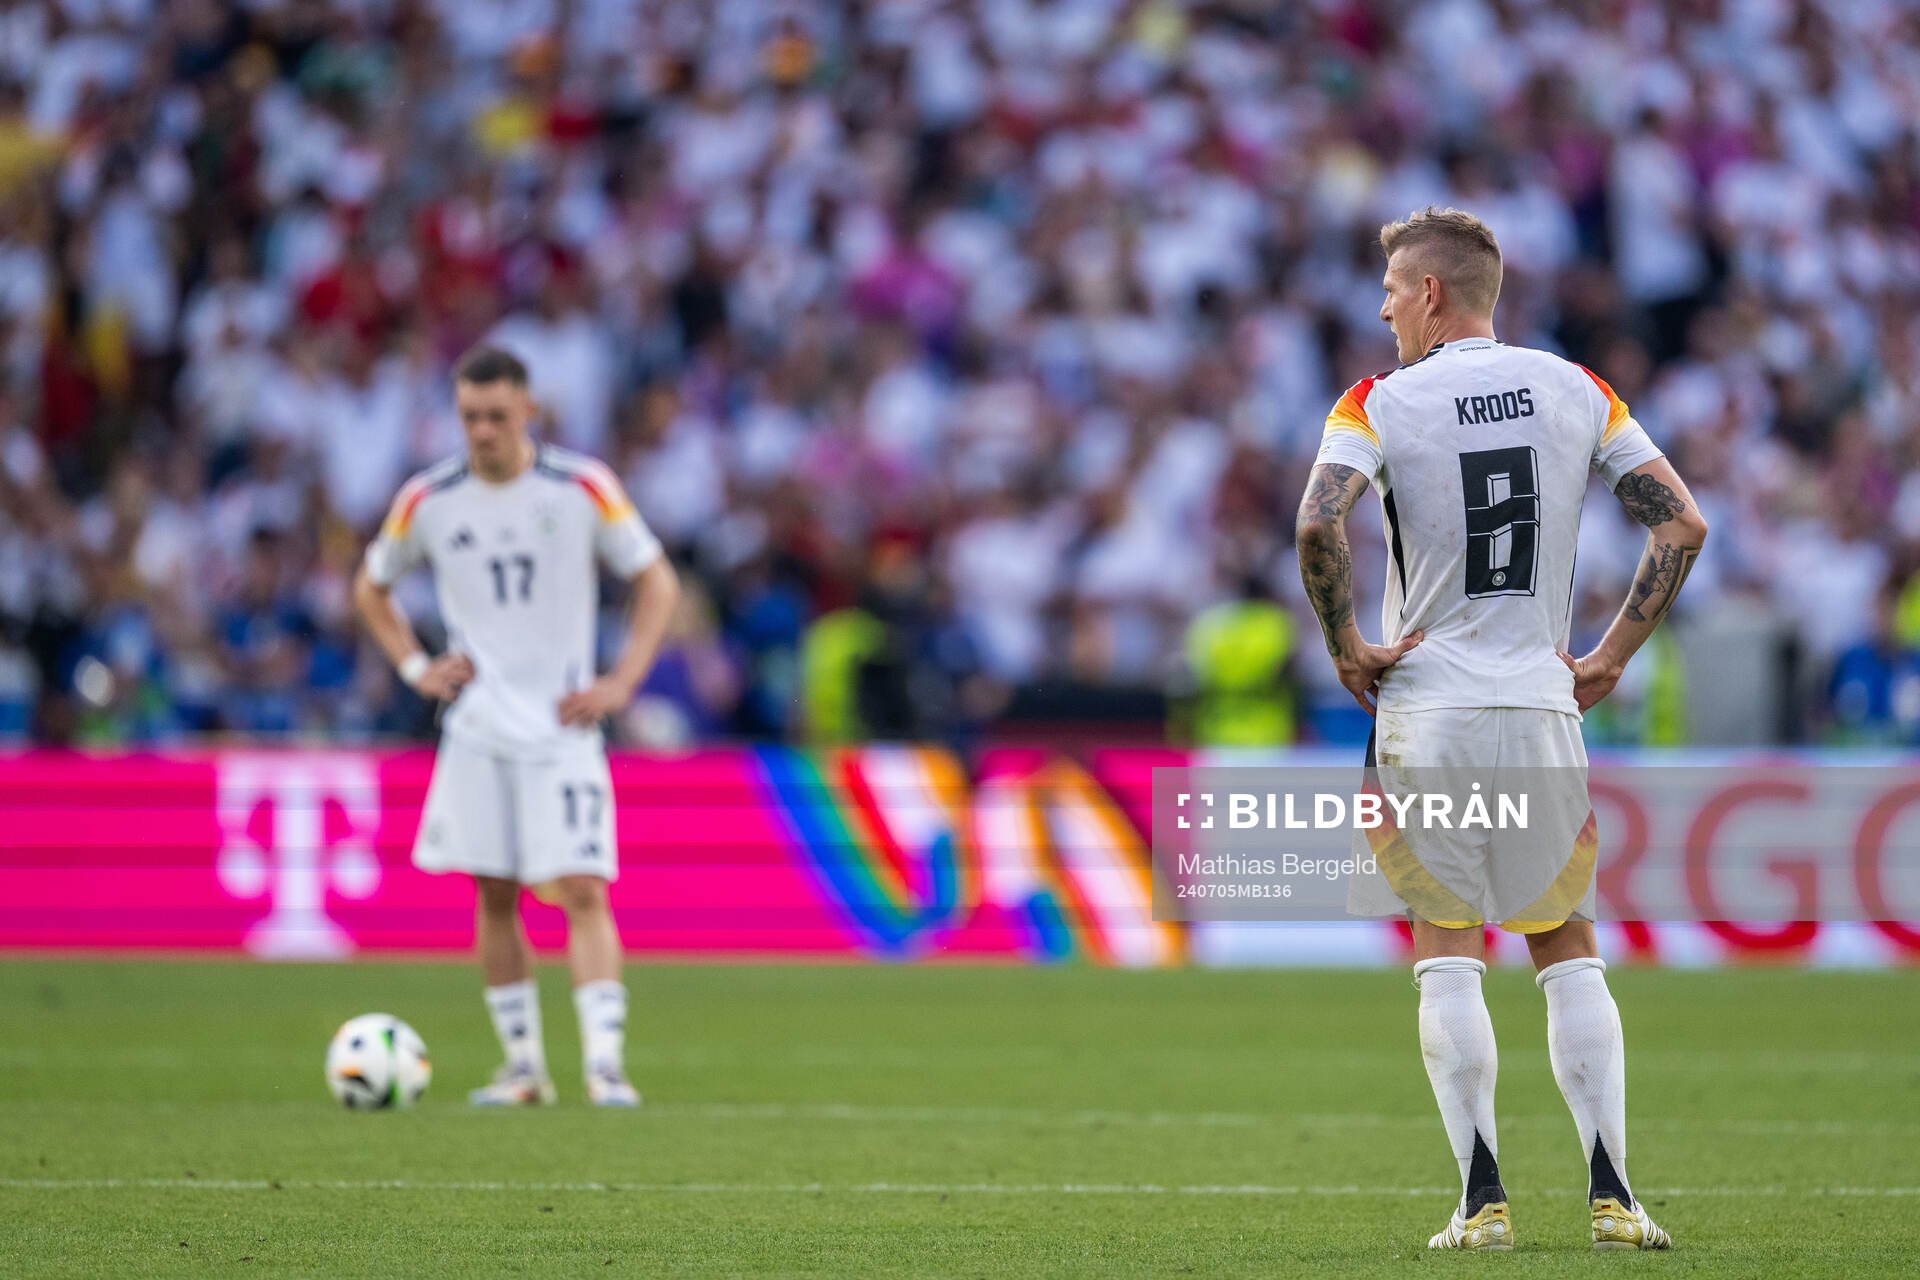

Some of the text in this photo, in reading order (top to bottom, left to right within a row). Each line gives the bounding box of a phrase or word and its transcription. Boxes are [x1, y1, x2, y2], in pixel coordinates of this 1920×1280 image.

[1454, 387, 1535, 425] KROOS
[1459, 446, 1541, 600] 8
[489, 553, 536, 607] 17
[561, 781, 603, 830] 17
[215, 752, 382, 962] T
